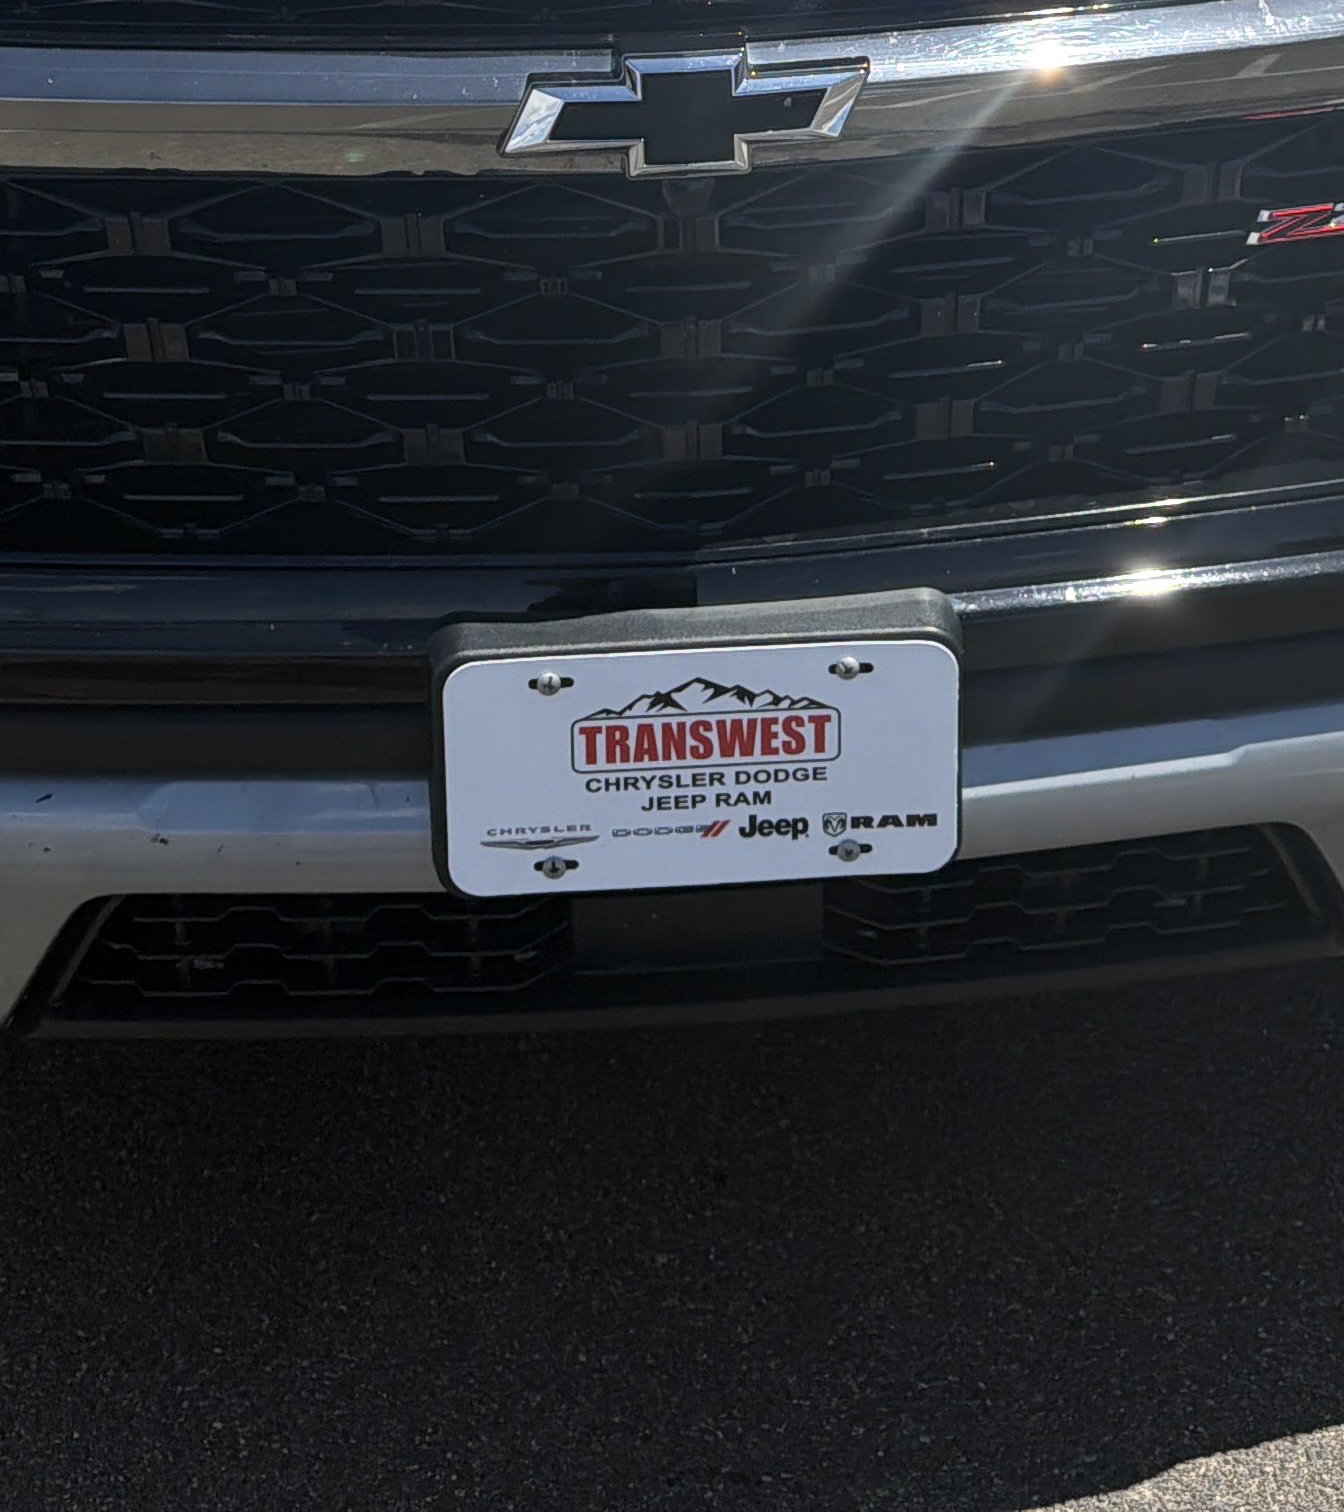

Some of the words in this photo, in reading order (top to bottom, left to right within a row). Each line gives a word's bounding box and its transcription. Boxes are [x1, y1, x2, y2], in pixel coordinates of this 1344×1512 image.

[578, 714, 832, 766] TRANSWEST
[584, 770, 726, 793] CHRYSLER
[734, 765, 828, 785] DODGE
[640, 795, 706, 812] JEEP
[715, 790, 772, 807] RAM
[486, 824, 592, 837] CHRYSLER
[611, 825, 717, 838] DODGE
[738, 814, 809, 840] Jeep
[850, 813, 938, 829] RAM
